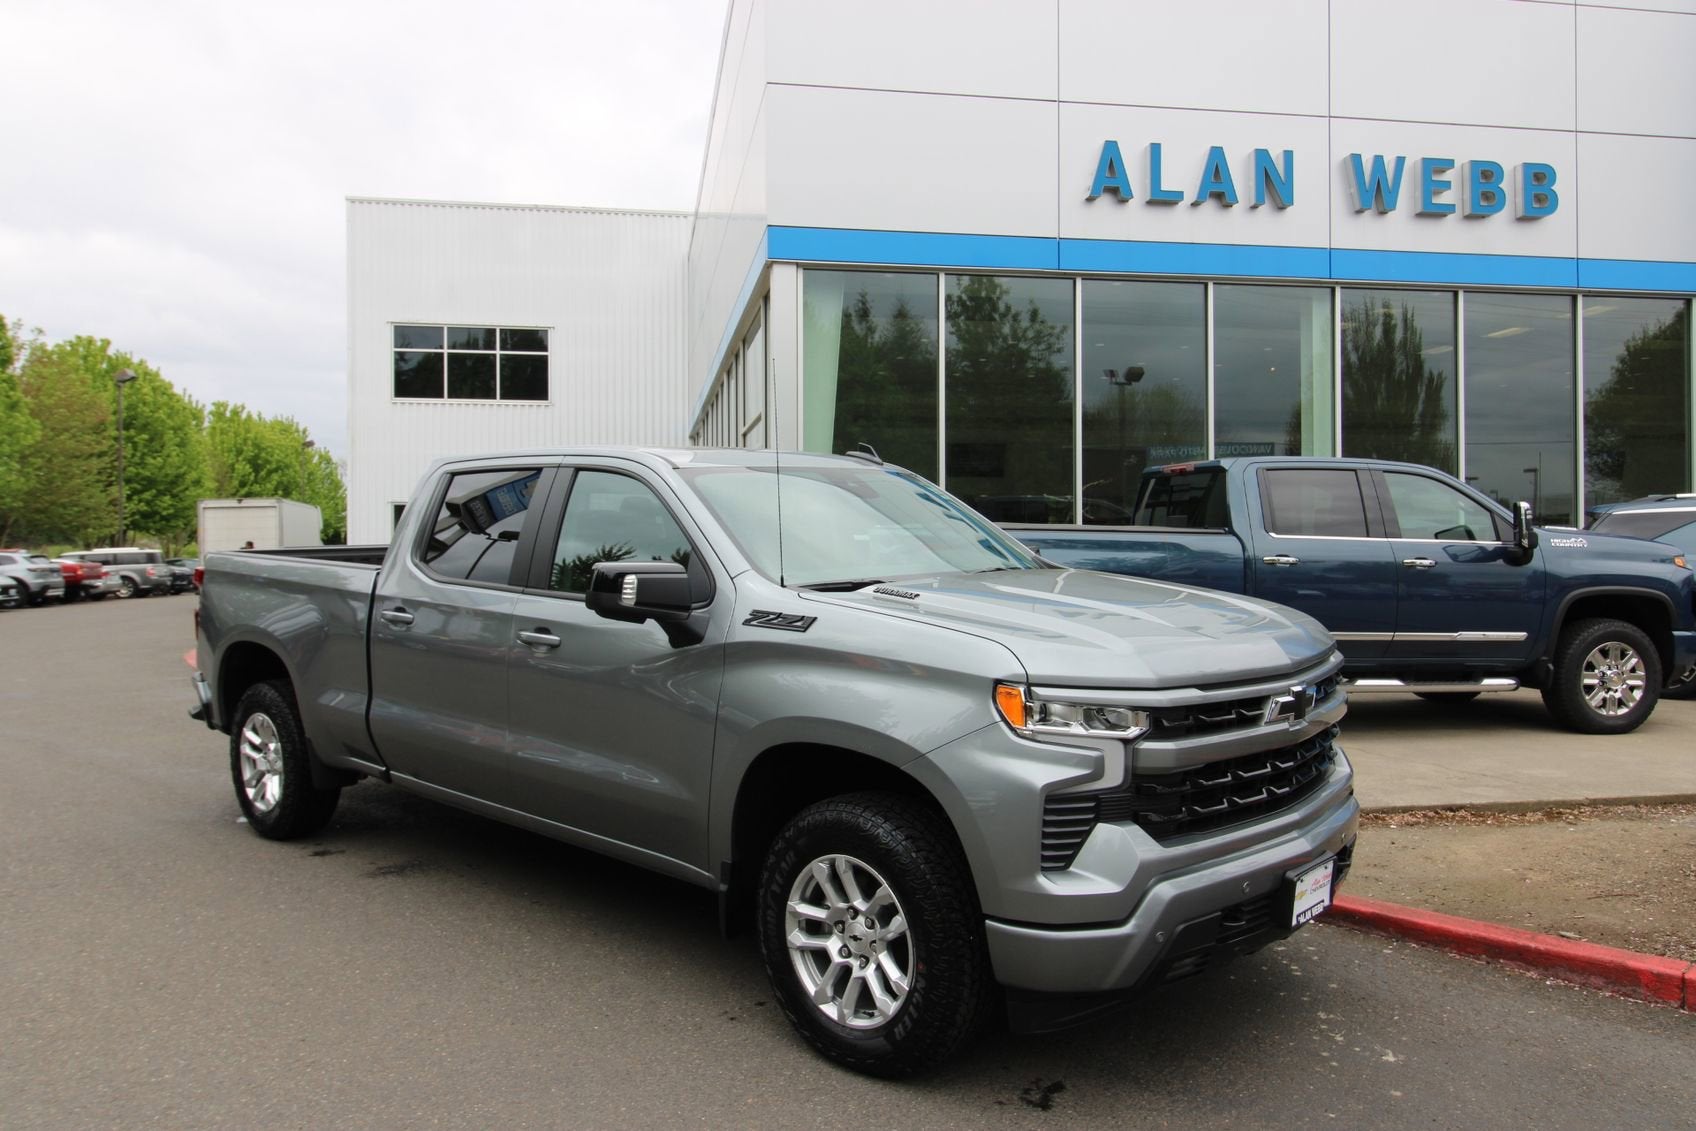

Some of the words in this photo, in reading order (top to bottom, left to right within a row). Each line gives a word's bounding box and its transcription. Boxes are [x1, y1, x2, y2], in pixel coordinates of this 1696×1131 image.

[1085, 139, 1294, 209] ALAN
[1344, 152, 1560, 220] WEBB
[742, 610, 818, 632] Z71
